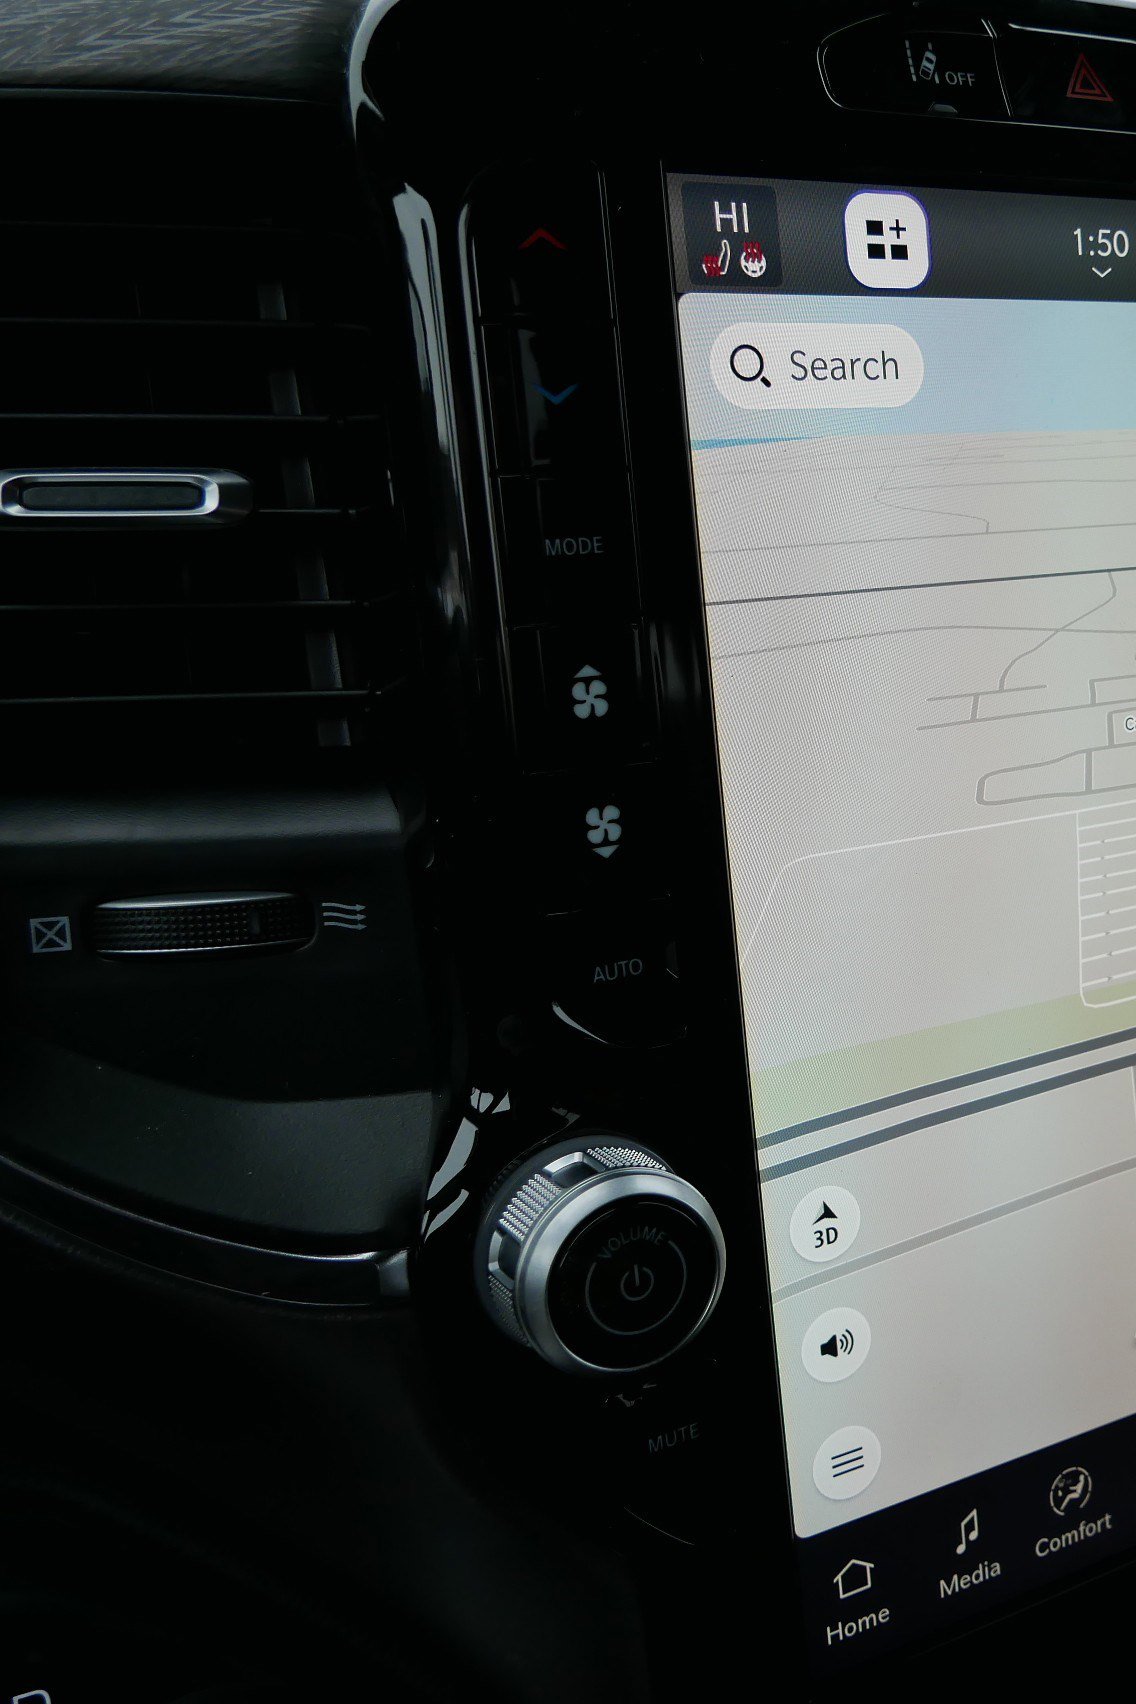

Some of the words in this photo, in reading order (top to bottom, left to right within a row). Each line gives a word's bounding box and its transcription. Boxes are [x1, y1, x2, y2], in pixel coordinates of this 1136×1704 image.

[945, 71, 976, 87] OFF
[713, 201, 751, 234] HI
[1072, 227, 1129, 259] 1:50
[790, 347, 900, 384] Search
[544, 536, 605, 557] MODE
[593, 958, 644, 984] AUTO
[596, 1225, 668, 1259] VOLUME
[814, 1226, 839, 1249] 3D
[647, 1422, 701, 1454] MUTE
[1035, 1513, 1113, 1558] Comfort
[938, 1560, 1002, 1599] Media
[826, 1606, 891, 1646] Home
